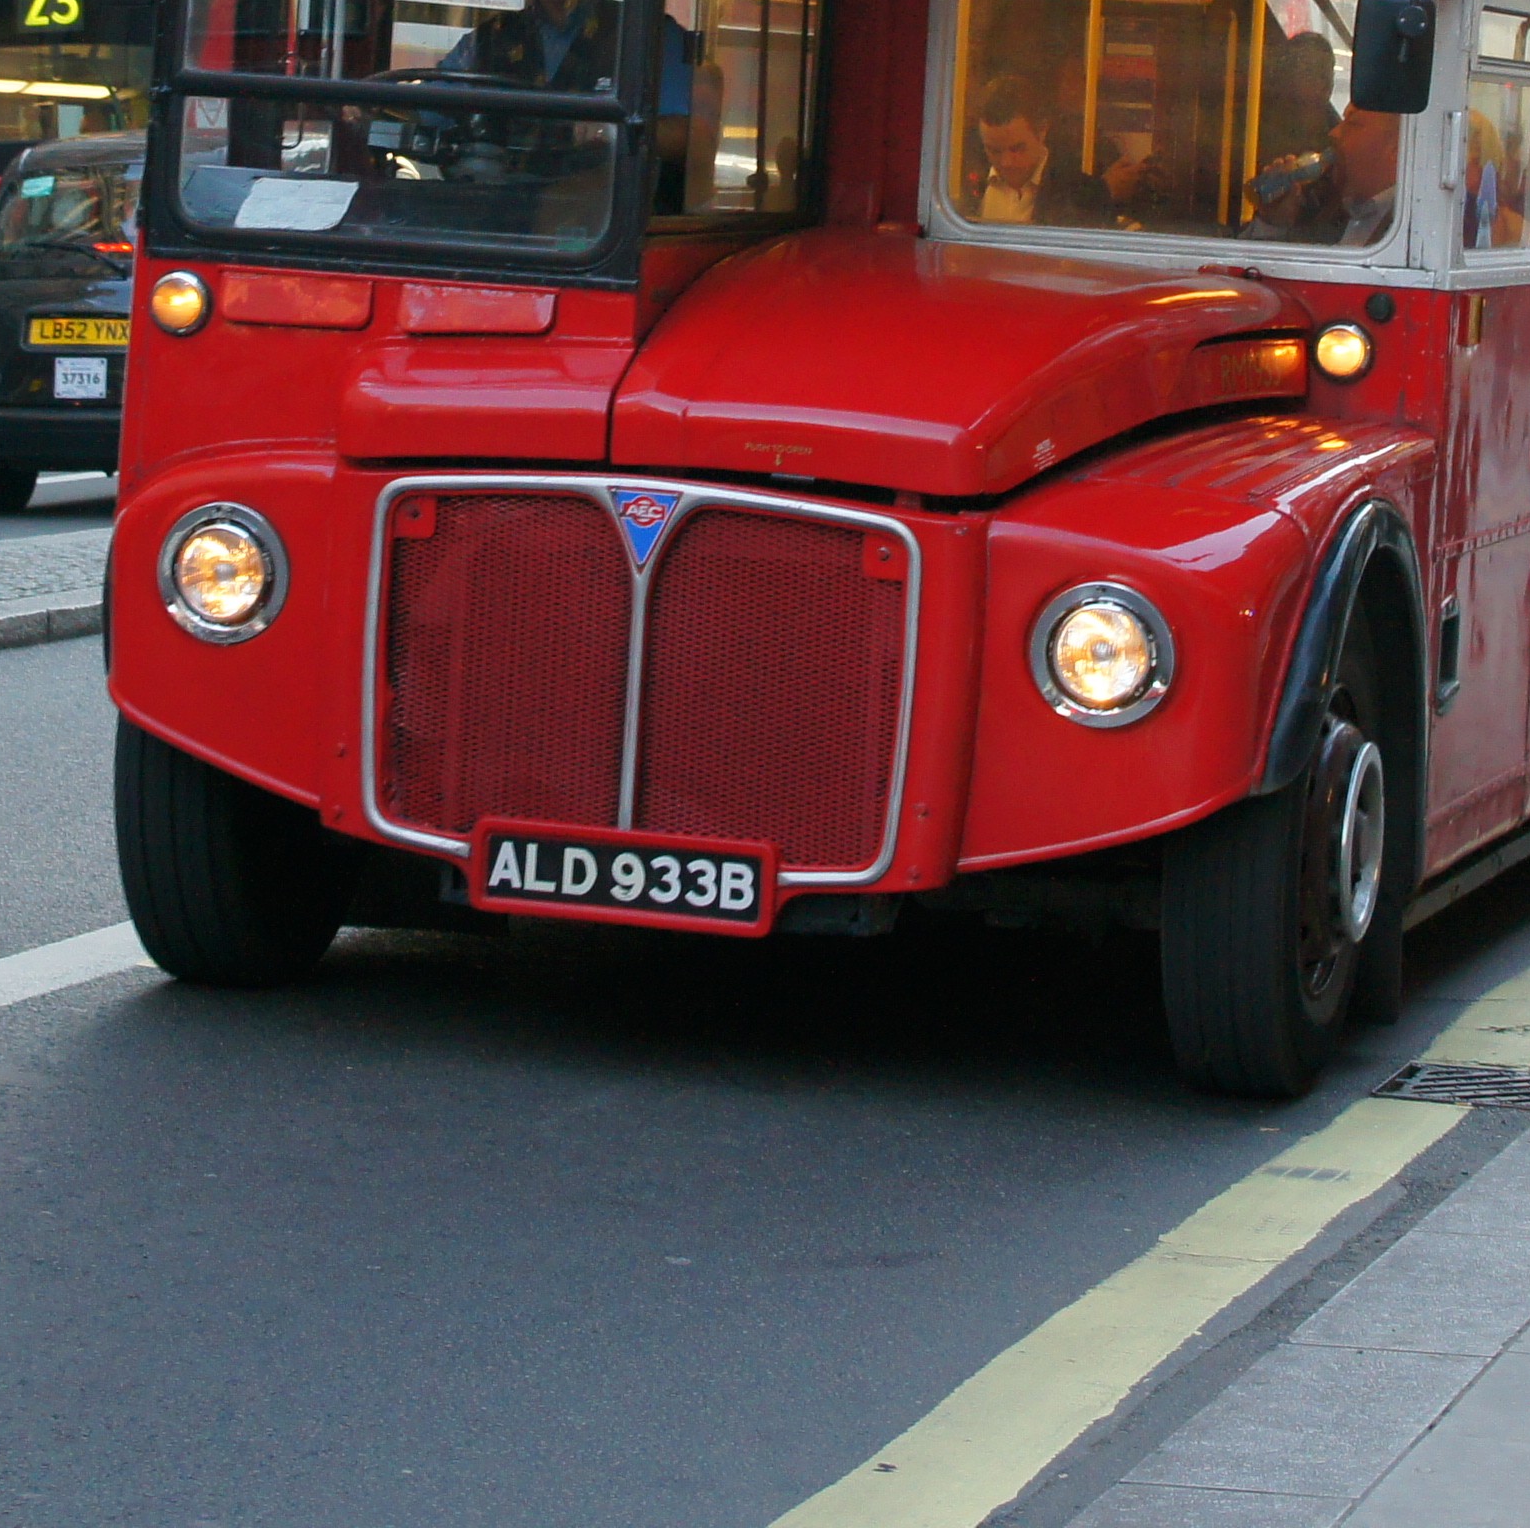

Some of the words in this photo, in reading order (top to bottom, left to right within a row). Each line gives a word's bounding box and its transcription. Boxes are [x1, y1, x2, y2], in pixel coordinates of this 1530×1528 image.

[40, 321, 87, 339] LB52
[61, 372, 101, 385] 37316
[625, 503, 664, 519] AEC
[487, 840, 598, 896] ALD
[609, 850, 756, 912] 933B
